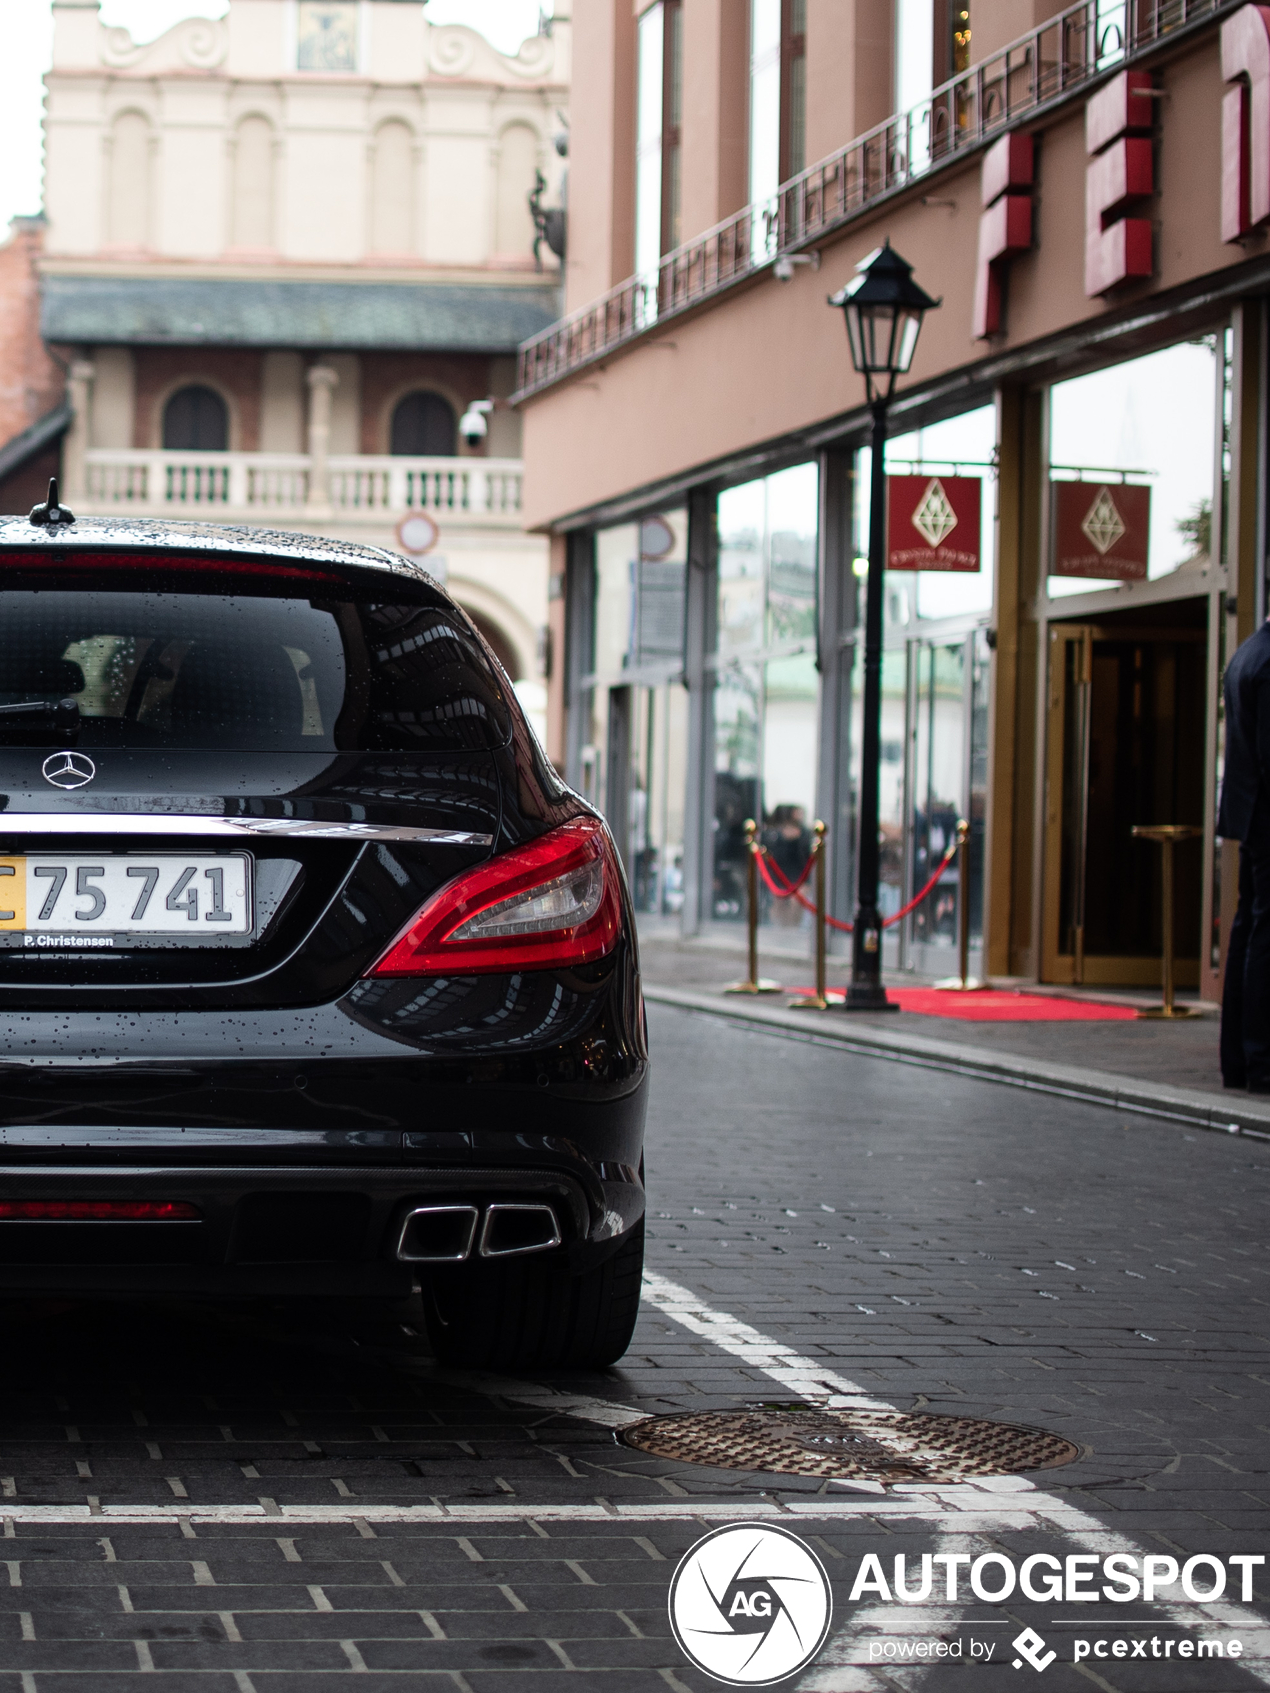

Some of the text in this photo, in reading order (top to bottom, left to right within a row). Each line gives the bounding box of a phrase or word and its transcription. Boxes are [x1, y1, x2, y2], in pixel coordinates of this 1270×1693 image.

[34, 866, 107, 921] 75
[126, 866, 232, 921] 741
[24, 935, 114, 947] P. Christensen
